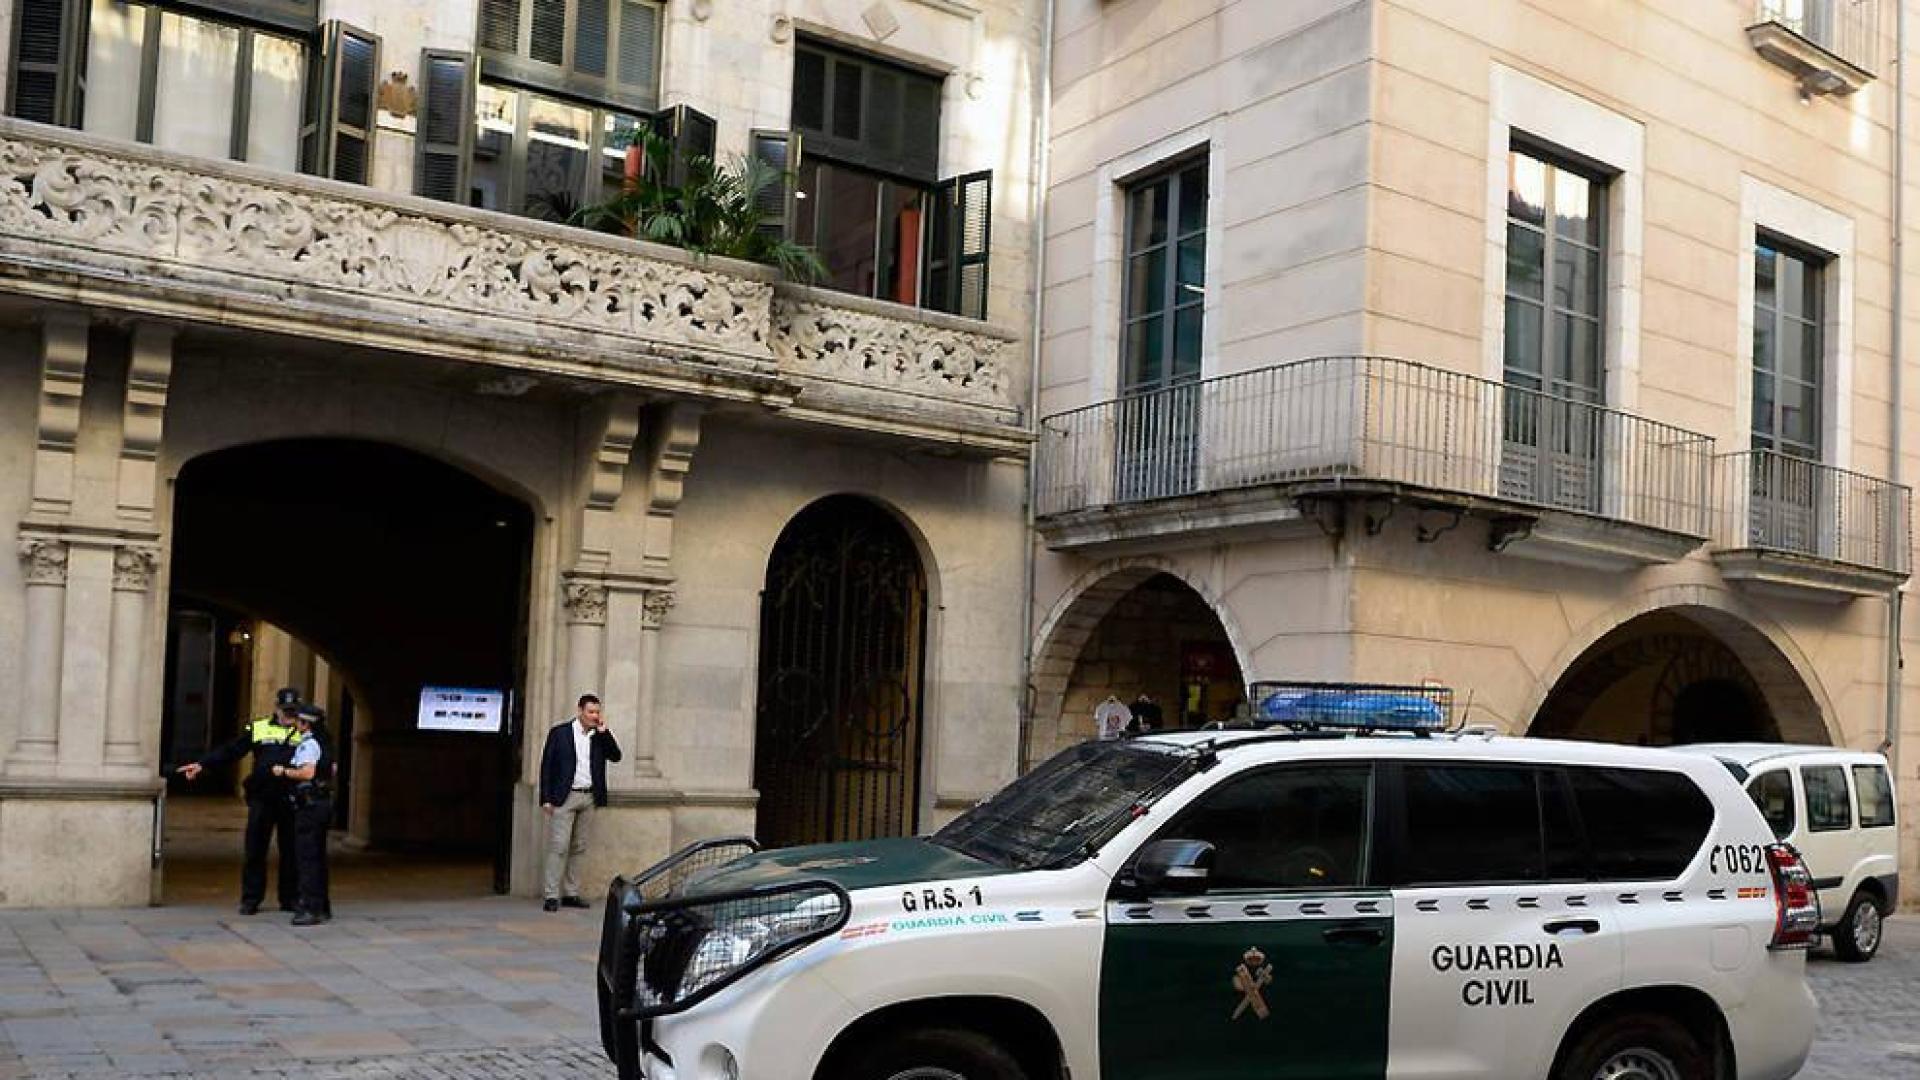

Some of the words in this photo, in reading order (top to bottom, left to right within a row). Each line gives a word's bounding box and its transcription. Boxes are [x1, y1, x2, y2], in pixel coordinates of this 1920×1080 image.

[1725, 845, 1765, 873] 062
[969, 885, 982, 906] 1
[892, 915, 965, 931] GUARDIA
[969, 913, 1008, 924] CIVIL
[1432, 943, 1564, 972] GUARDIA
[1462, 979, 1535, 1006] CIVIL
